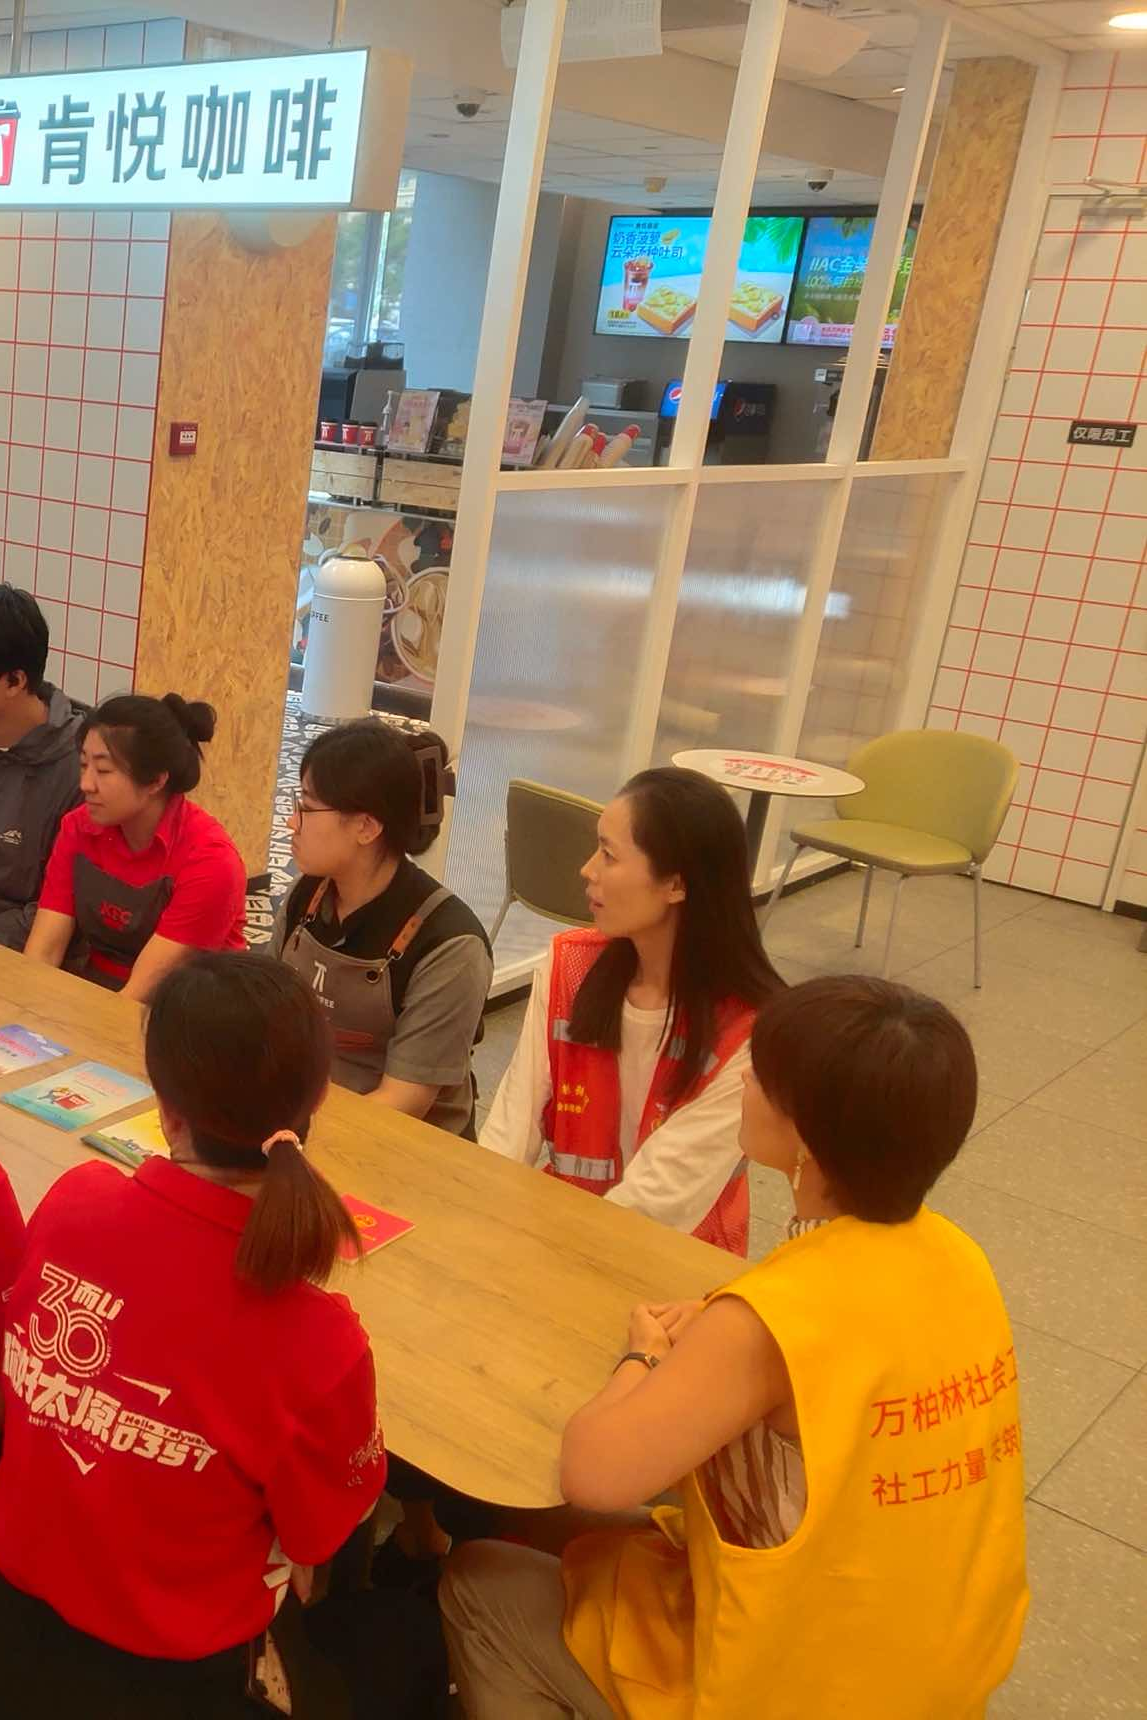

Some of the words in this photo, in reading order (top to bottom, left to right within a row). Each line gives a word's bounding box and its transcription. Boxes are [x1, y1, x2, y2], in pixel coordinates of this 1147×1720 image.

[38, 77, 338, 186] 肯悦咖啡
[1073, 426, 1133, 443] 仅限员工
[124, 1412, 156, 1432] Hello
